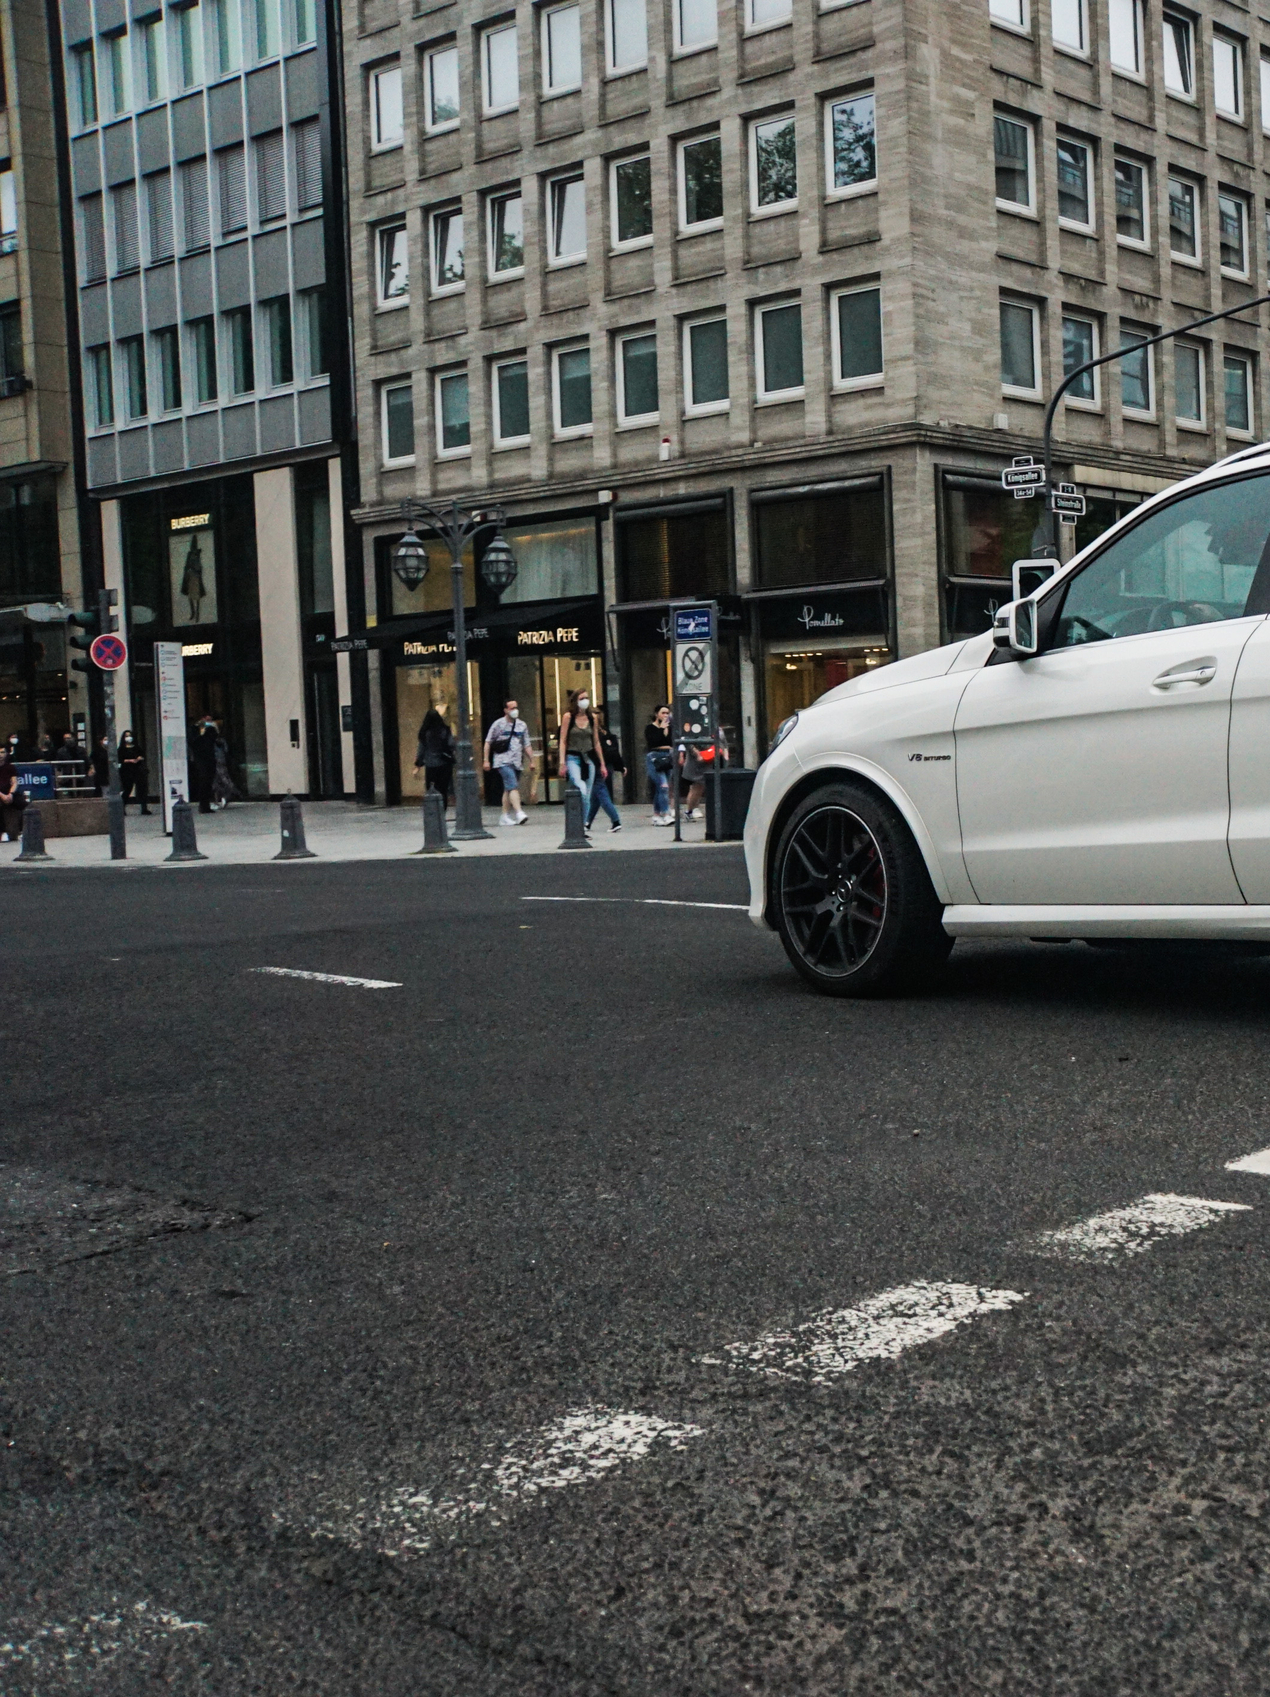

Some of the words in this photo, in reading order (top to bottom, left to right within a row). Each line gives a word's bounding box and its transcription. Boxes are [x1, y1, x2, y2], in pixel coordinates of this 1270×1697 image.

[171, 513, 210, 529] BURBERRY
[694, 615, 708, 624] Zone
[518, 630, 555, 645] PATRIZIA
[556, 627, 579, 642] PEPE
[181, 643, 213, 656] RBERRY
[685, 682, 703, 691] ZONE
[17, 773, 48, 785] allee
